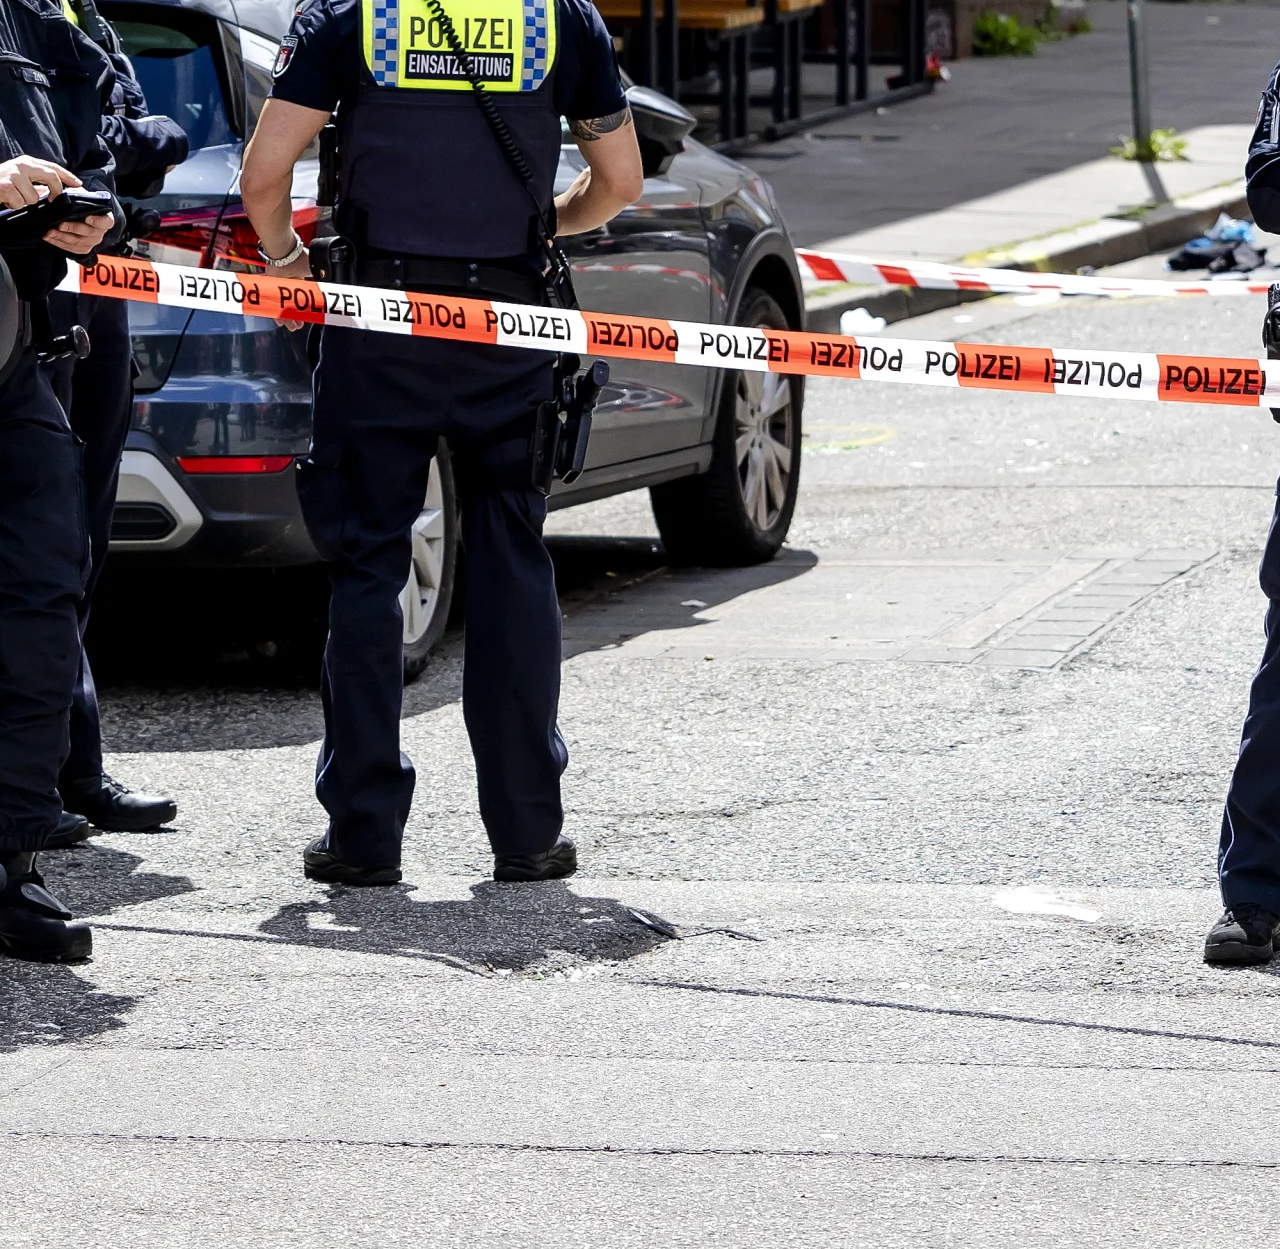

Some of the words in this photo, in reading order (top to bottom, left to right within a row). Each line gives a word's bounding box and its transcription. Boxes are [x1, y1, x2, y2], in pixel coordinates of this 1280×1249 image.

[83, 266, 161, 293] POLIZEI
[180, 273, 260, 305] POLIZEI
[278, 286, 362, 317] POLIZEI
[381, 297, 466, 330] POLIZEI
[486, 309, 572, 341] POLIZEI
[590, 320, 679, 352] POLIZEI
[699, 331, 790, 363] POLIZEI
[810, 340, 903, 372] POLIZEI
[924, 350, 1021, 382] POLIZEI
[1044, 357, 1143, 389] POLIZEI
[1164, 364, 1267, 396] POLIZEI
